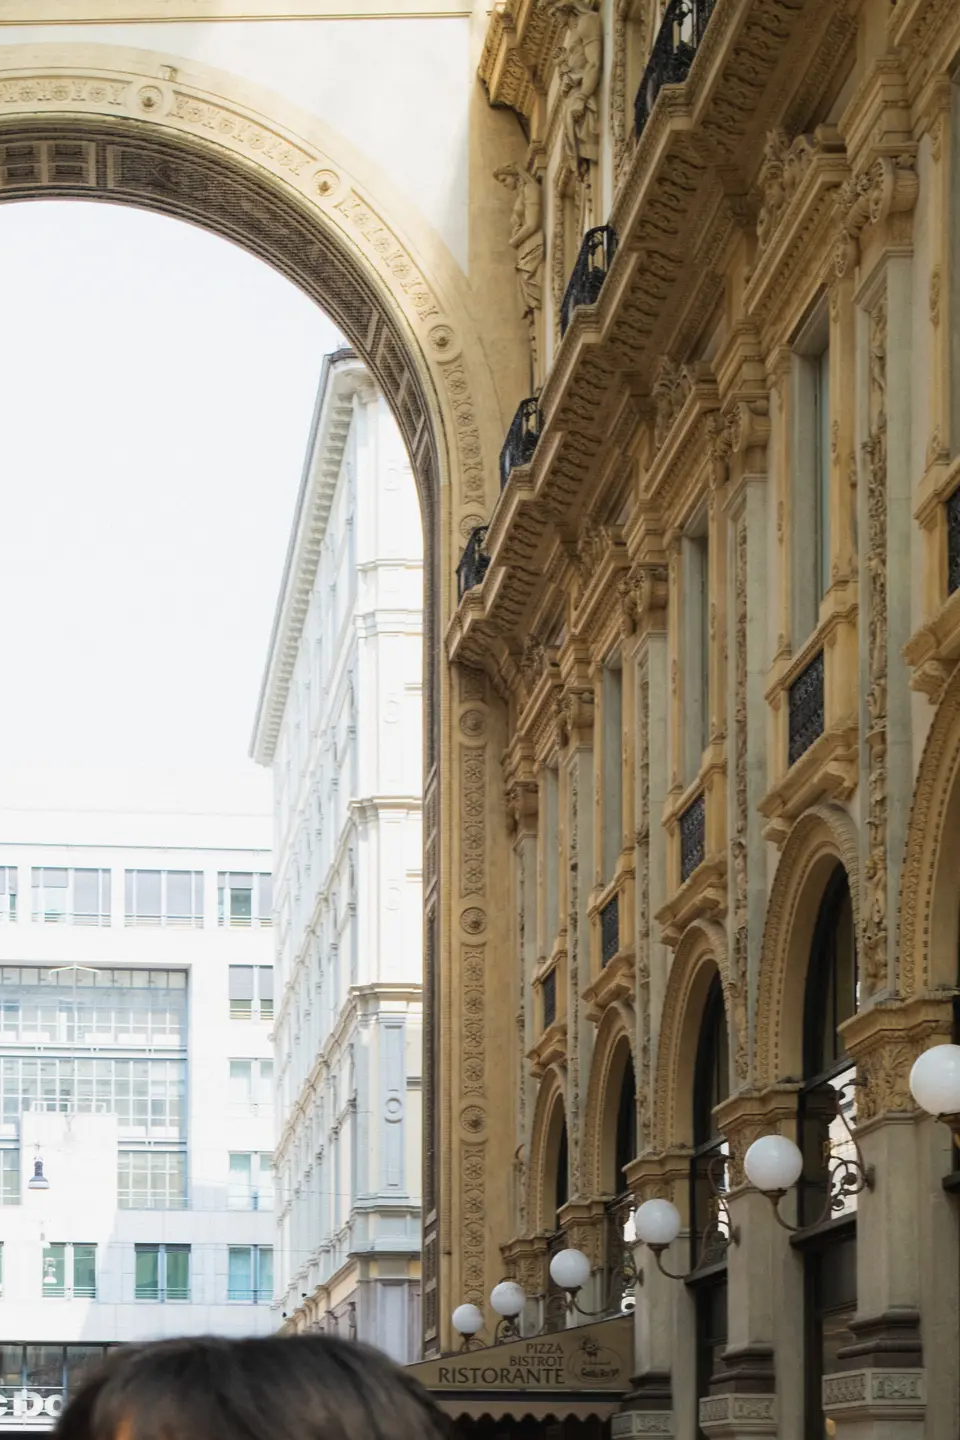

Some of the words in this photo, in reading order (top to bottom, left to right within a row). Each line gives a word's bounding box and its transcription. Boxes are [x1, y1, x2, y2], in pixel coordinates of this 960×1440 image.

[526, 1343, 564, 1354] PIZZA
[509, 1355, 564, 1367] BISTROT
[438, 1367, 565, 1384] RISTORANTE
